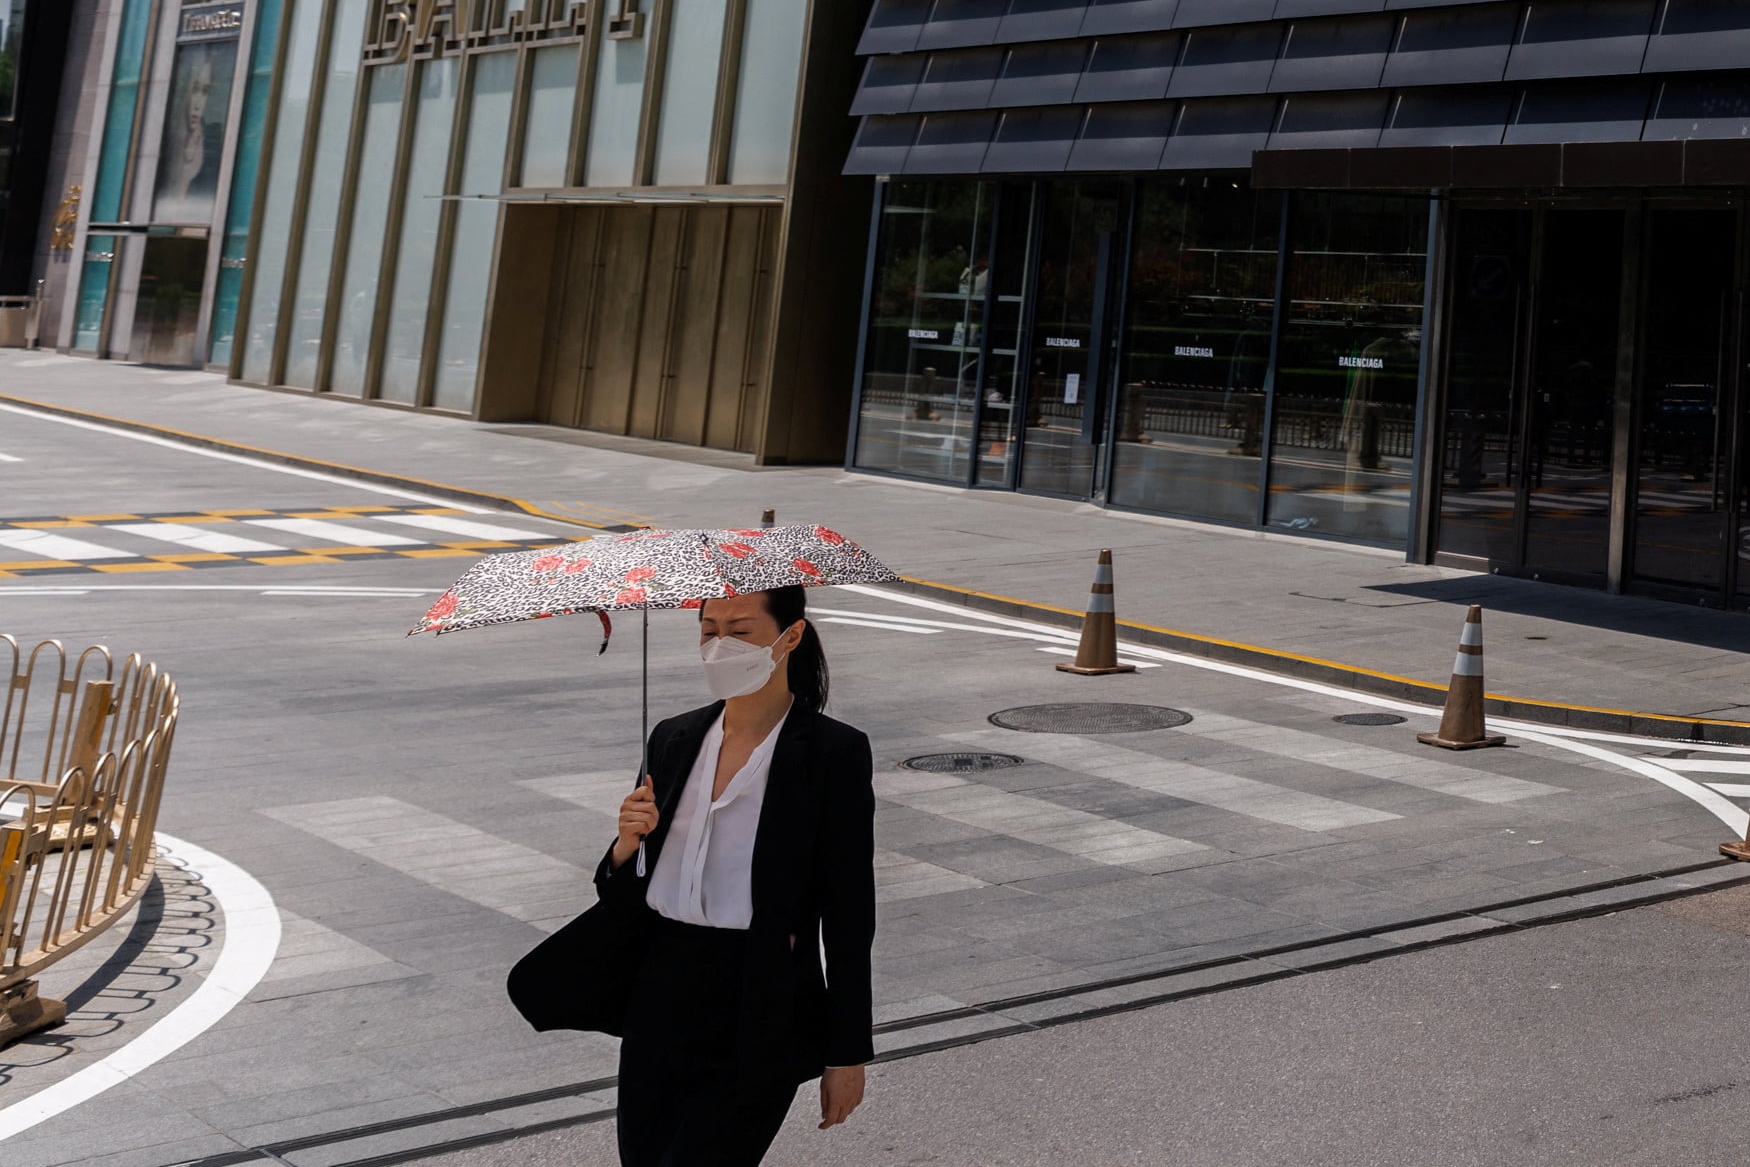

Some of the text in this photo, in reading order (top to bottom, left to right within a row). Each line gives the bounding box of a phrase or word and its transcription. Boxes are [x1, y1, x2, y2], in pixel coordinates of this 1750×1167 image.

[908, 329, 939, 340] BALENCIAGA
[1046, 336, 1081, 348] BALENCIAGA
[1174, 345, 1214, 358] BALENCIAGA
[1338, 356, 1384, 369] BALENCIAGA
